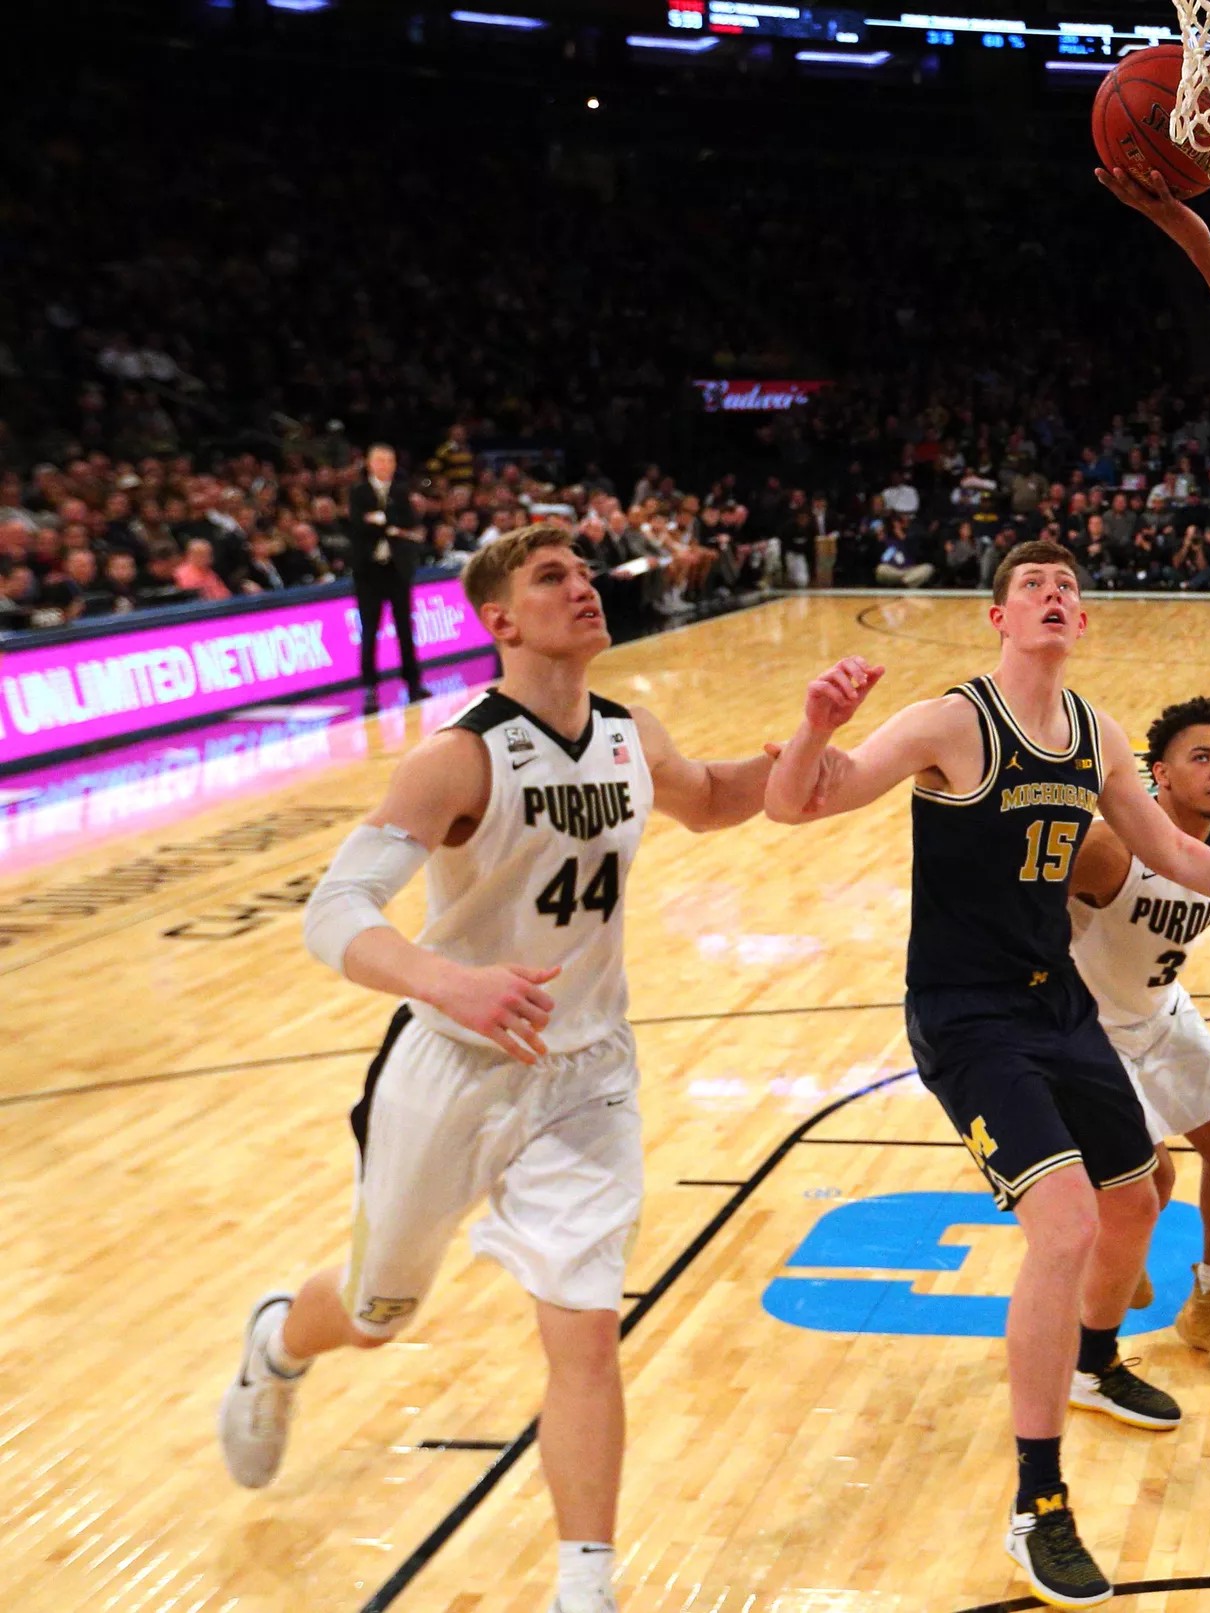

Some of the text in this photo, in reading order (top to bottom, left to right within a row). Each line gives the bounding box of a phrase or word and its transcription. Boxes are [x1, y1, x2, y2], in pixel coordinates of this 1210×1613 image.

[3, 620, 332, 735] UNLIMITED NETWORK
[523, 782, 634, 841] PURDUE
[1001, 783, 1098, 813] MICHIGAN
[1019, 820, 1079, 881] 15
[535, 852, 619, 928] 44
[1147, 950, 1187, 988] 3
